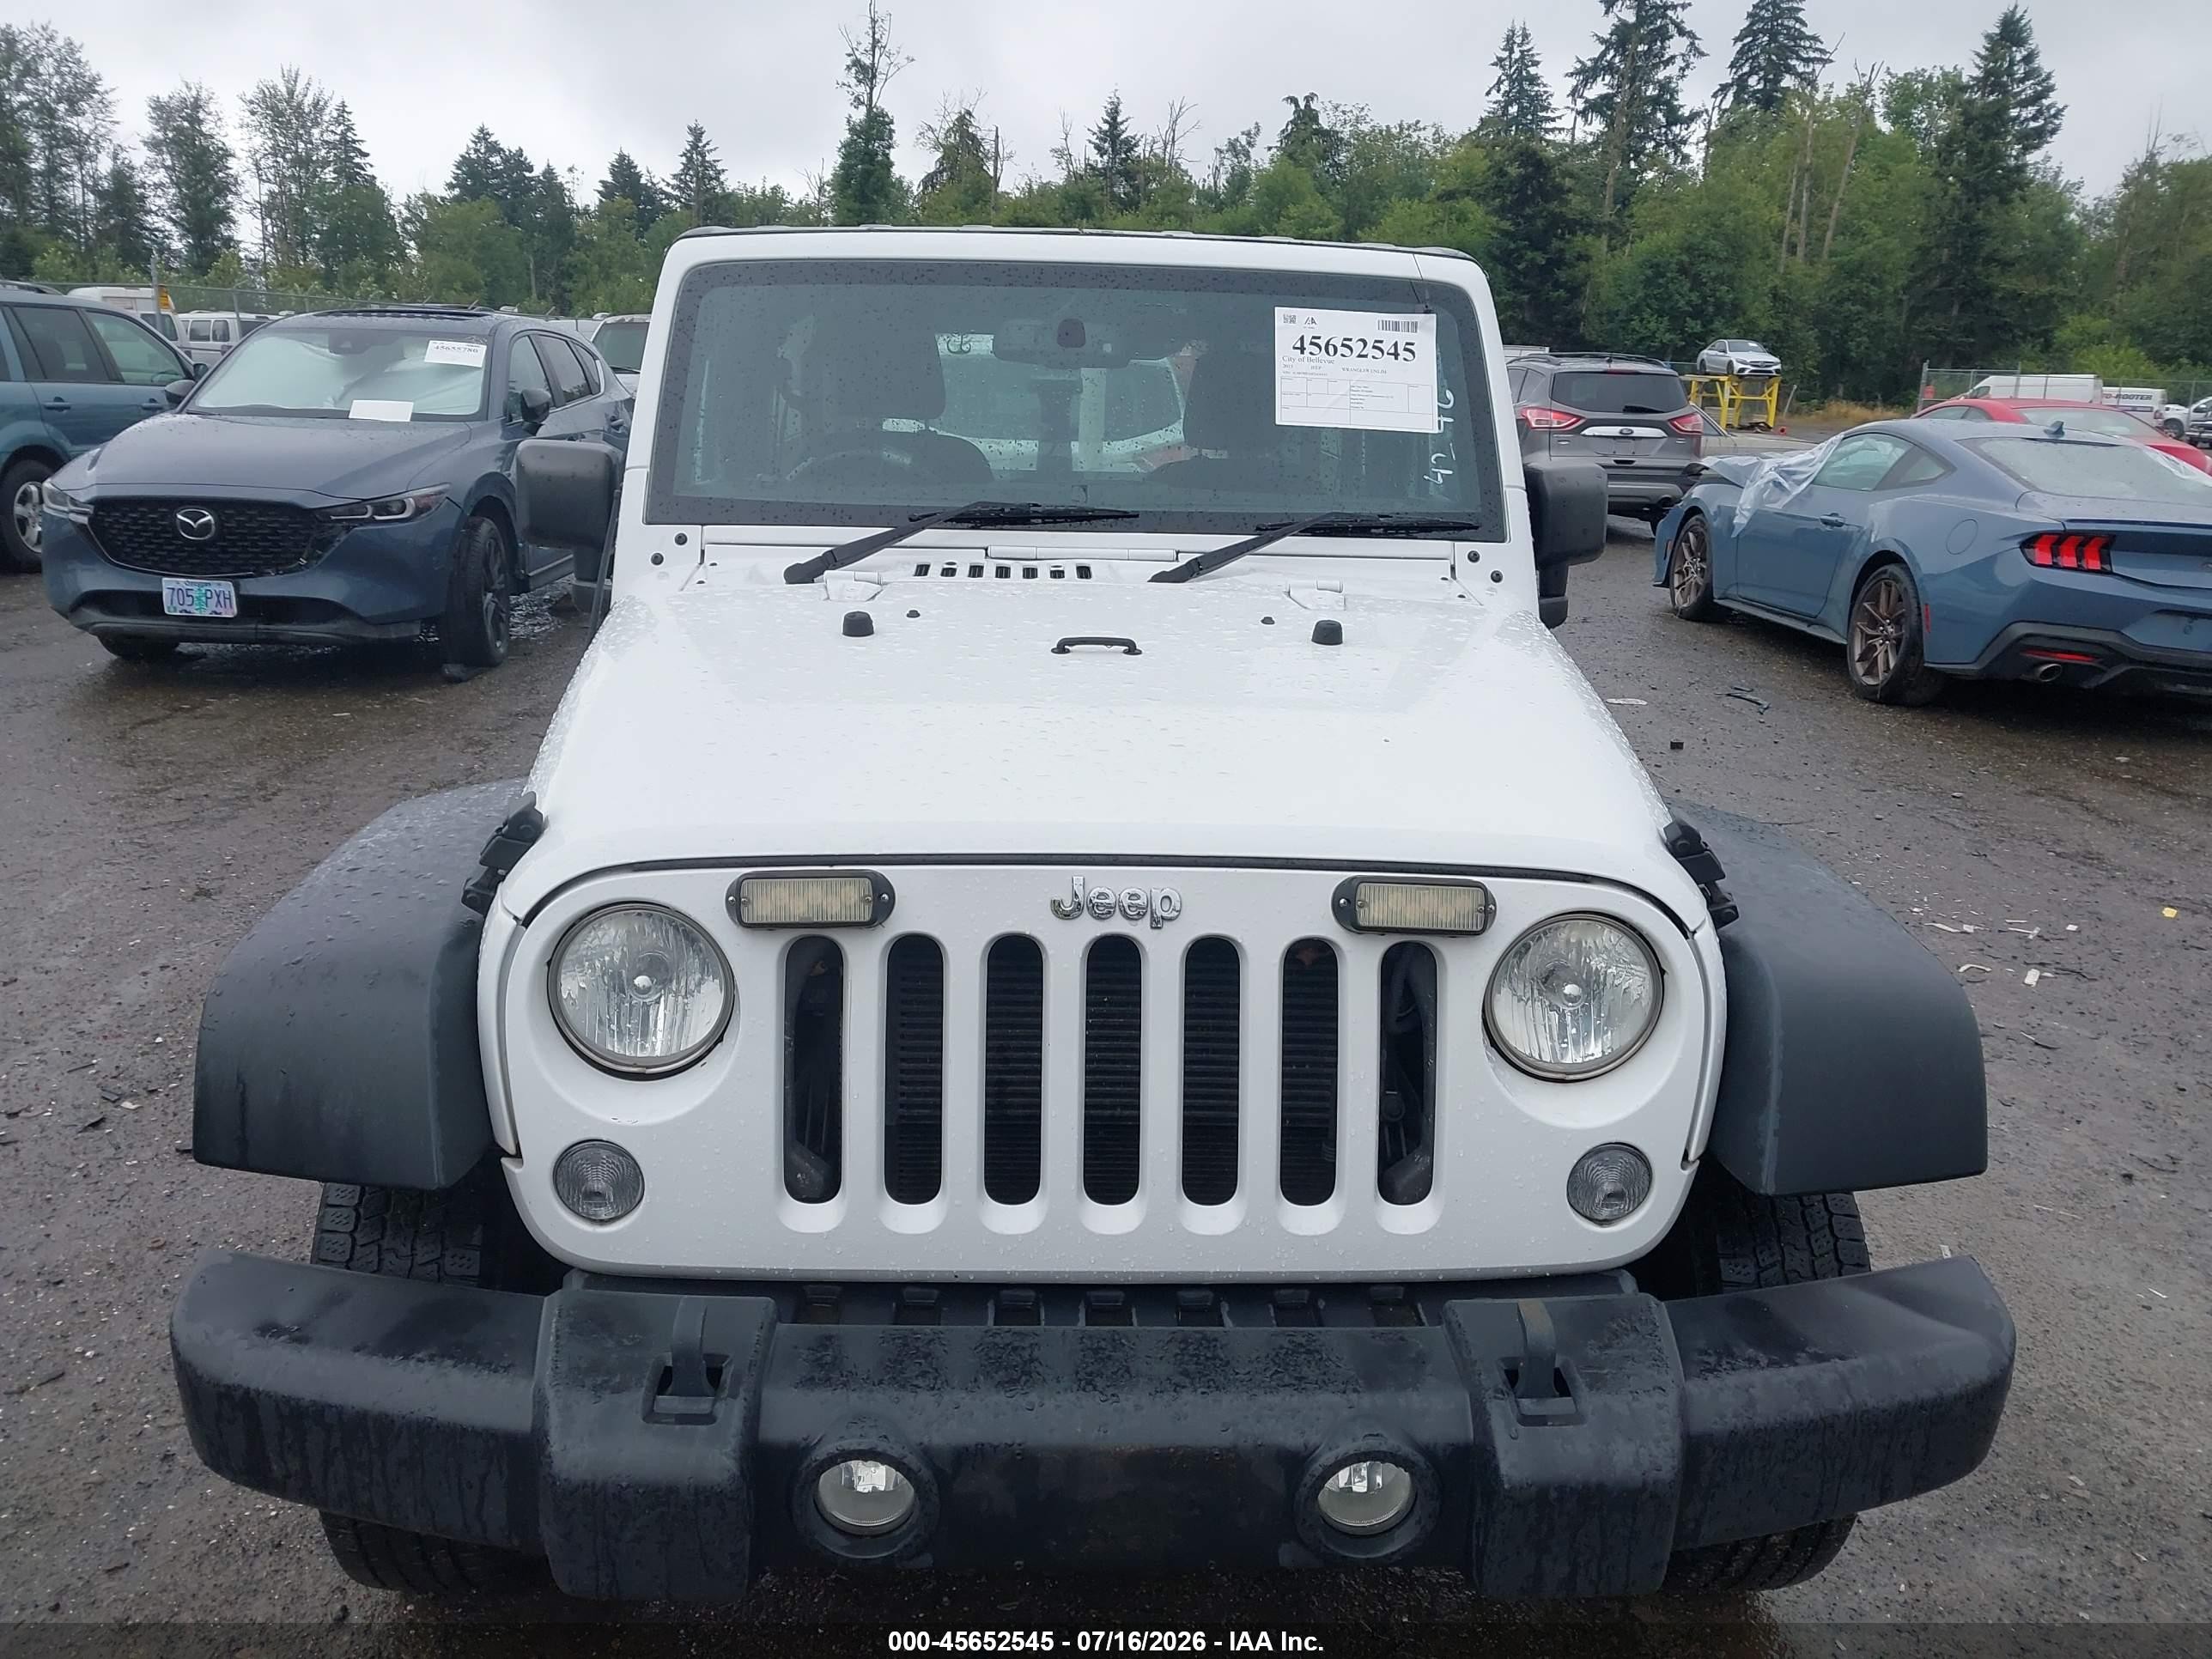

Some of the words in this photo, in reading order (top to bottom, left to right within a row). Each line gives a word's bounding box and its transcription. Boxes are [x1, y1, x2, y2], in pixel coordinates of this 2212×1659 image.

[1292, 335, 1416, 362] 45652545
[167, 587, 194, 606] 705
[205, 589, 233, 609] PXH
[1050, 875, 1182, 929] Jeep
